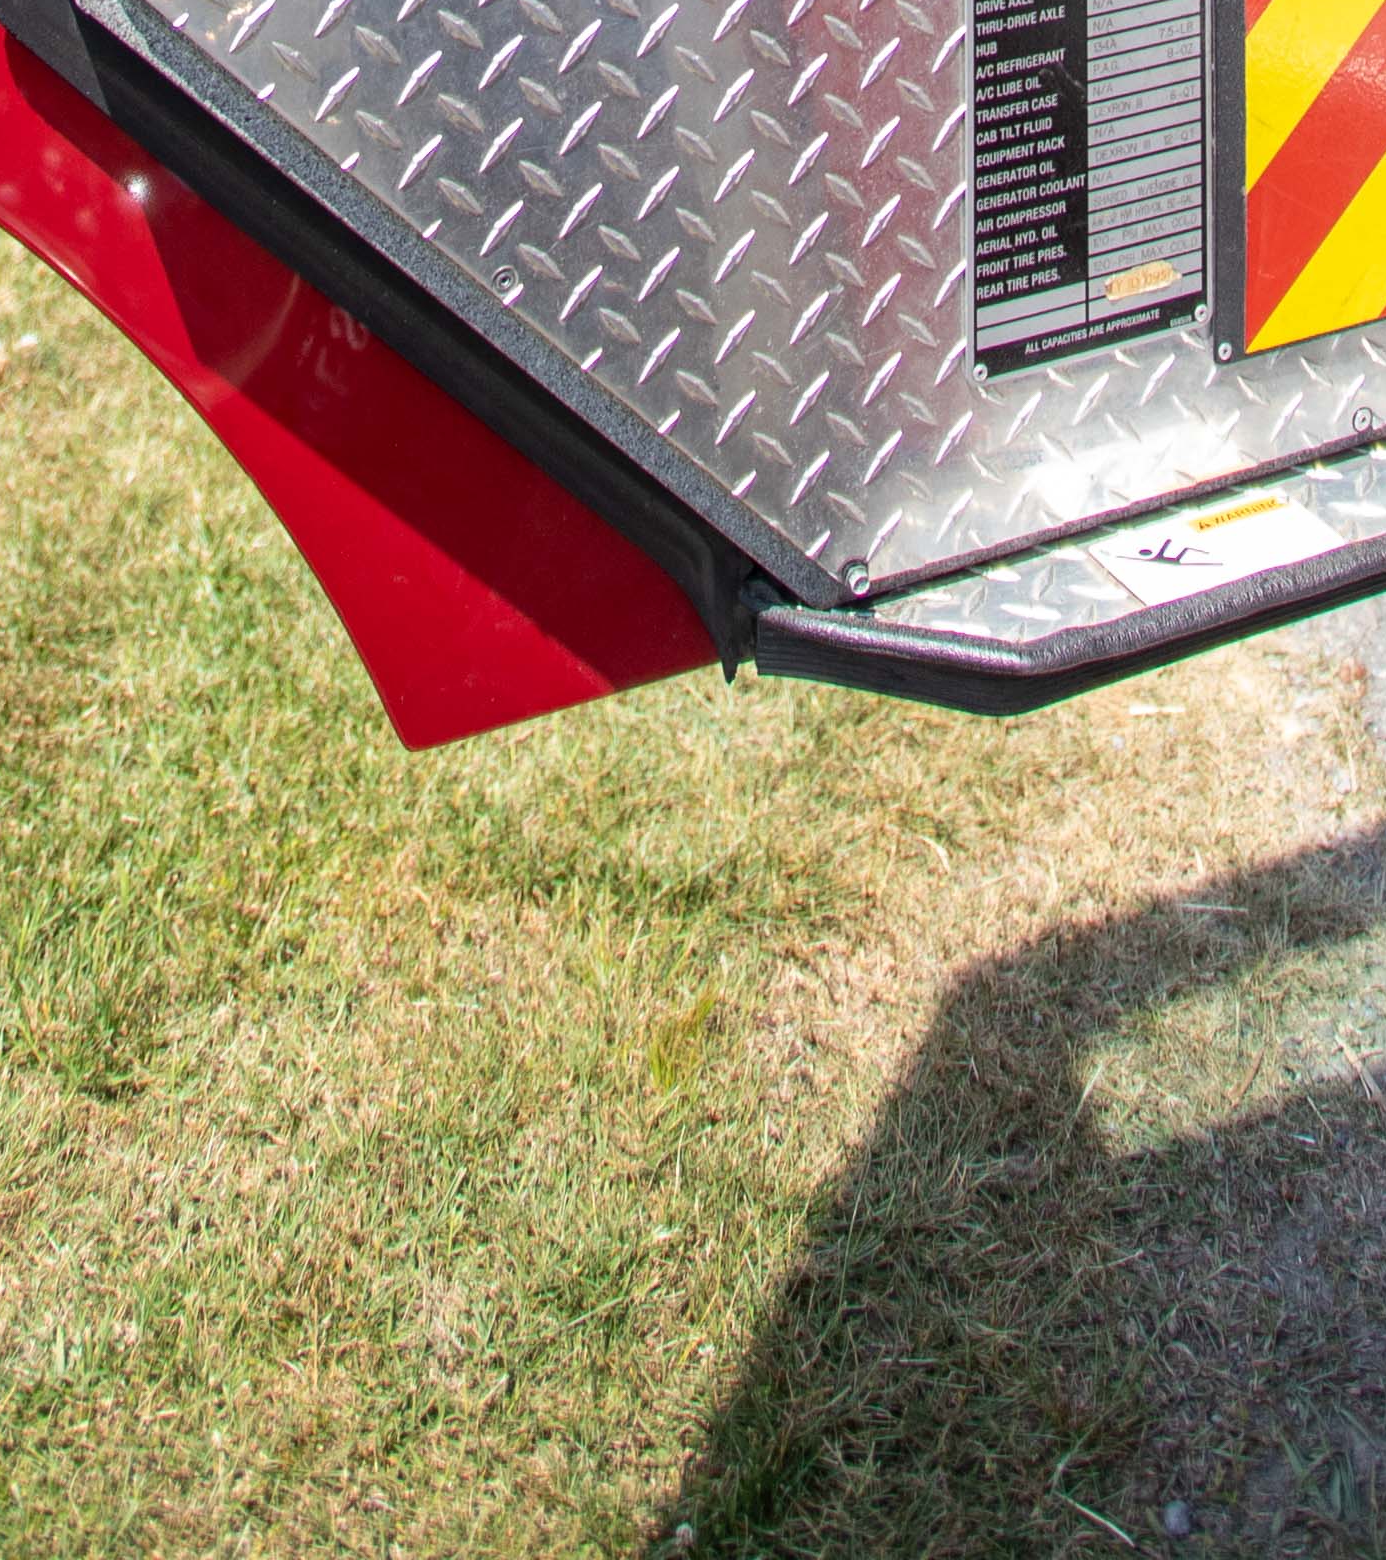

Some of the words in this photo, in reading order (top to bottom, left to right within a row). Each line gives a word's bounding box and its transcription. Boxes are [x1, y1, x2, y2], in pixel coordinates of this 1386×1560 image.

[975, 10, 1037, 36] THRU-DRIVE
[1039, 4, 1065, 22] AXLE
[975, 40, 997, 58] HUB
[975, 100, 1029, 124] TRANSFER
[1031, 93, 1058, 111] CASE
[976, 142, 1035, 168] EQUIPMENT
[1037, 135, 1065, 153] RACK
[976, 185, 1037, 212] GENERATOR
[1039, 173, 1086, 196] COOLANT
[1024, 340, 1040, 354] ALL
[1041, 327, 1087, 350] CAPACITIES
[1088, 322, 1104, 338] ARE
[1105, 307, 1160, 332] APPROXIMATE
